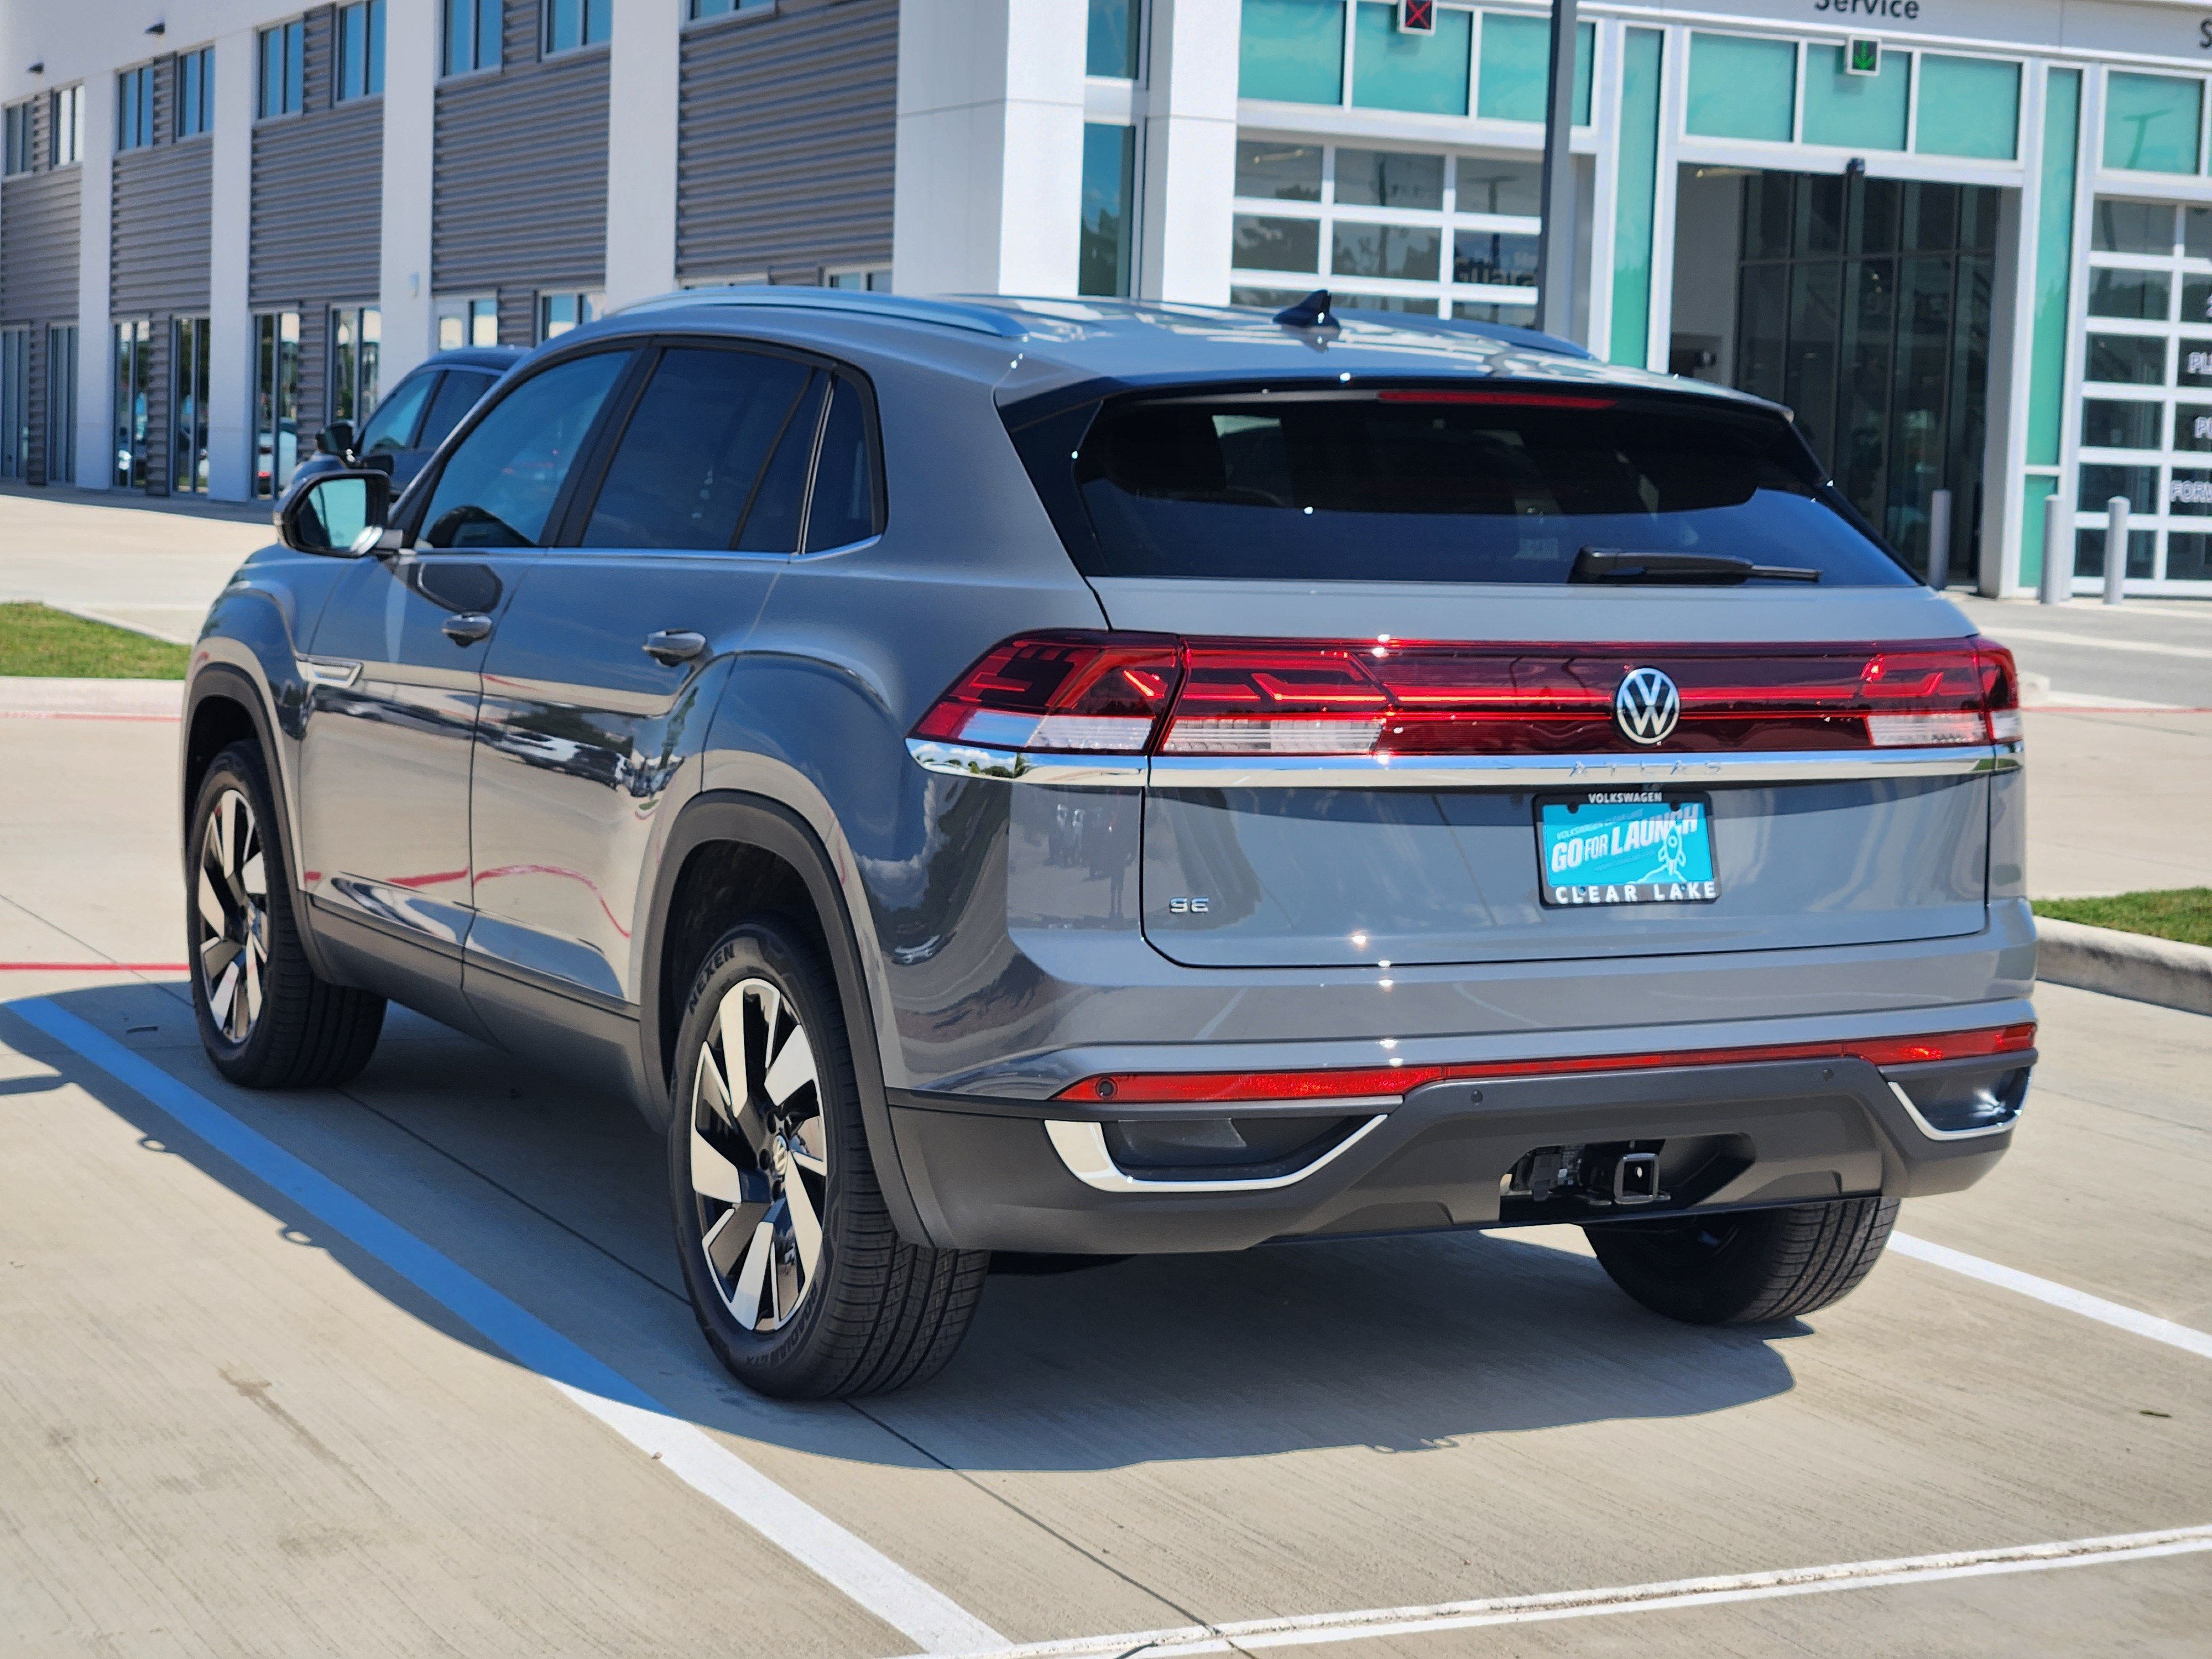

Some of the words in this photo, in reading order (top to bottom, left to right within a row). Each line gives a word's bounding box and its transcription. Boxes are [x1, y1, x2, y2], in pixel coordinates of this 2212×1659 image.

[2188, 352, 2212, 374] PL
[1588, 792, 1662, 804] VOLKSWAGEN
[1551, 837, 1583, 873] GO
[1584, 833, 1608, 861] FOR
[1611, 804, 1698, 856] LAUNCH
[1556, 884, 1638, 904] CLEAR
[1653, 881, 1716, 901] LAKE
[1170, 898, 1209, 913] SE
[689, 943, 735, 1015] NEXEN
